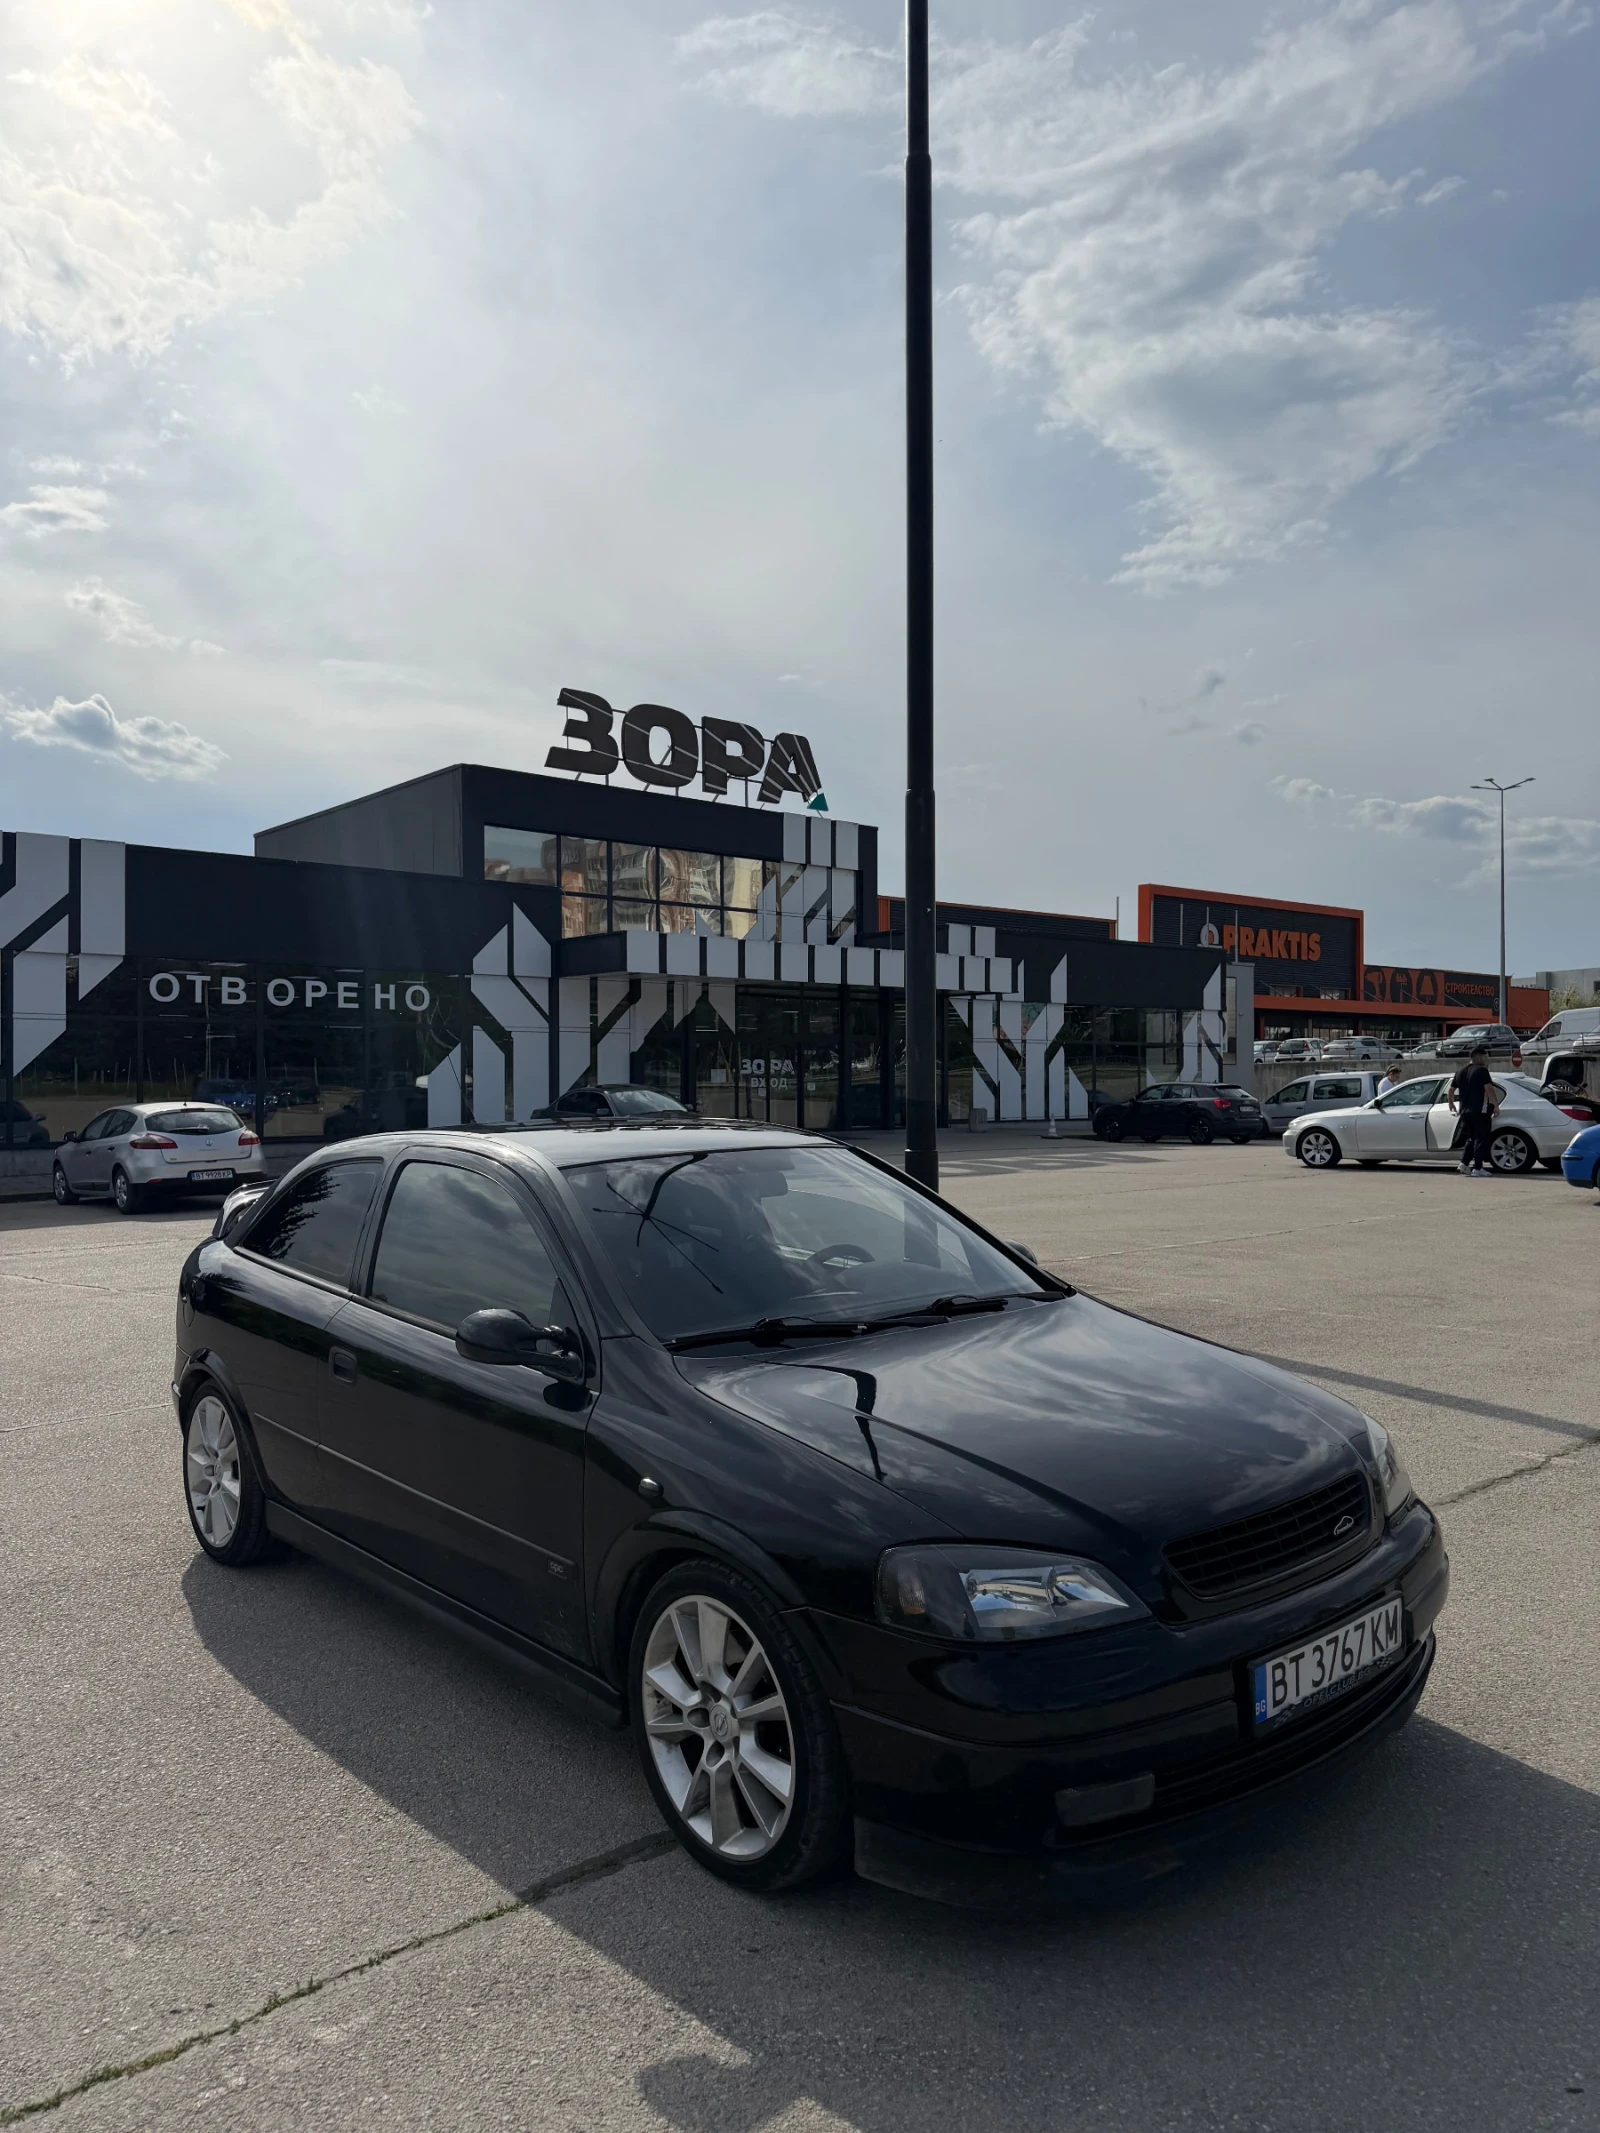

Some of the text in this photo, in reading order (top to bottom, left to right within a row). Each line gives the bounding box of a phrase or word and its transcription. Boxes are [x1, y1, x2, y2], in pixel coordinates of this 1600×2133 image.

[545, 687, 829, 812] ЗОРА
[1222, 924, 1321, 962] PRAKTIS
[1445, 982, 1495, 997] СТРОИТЕЛСТВО
[740, 1059, 795, 1075] ЗОРА
[751, 1077, 788, 1090] ВХОД
[1255, 1699, 1266, 1716] BG
